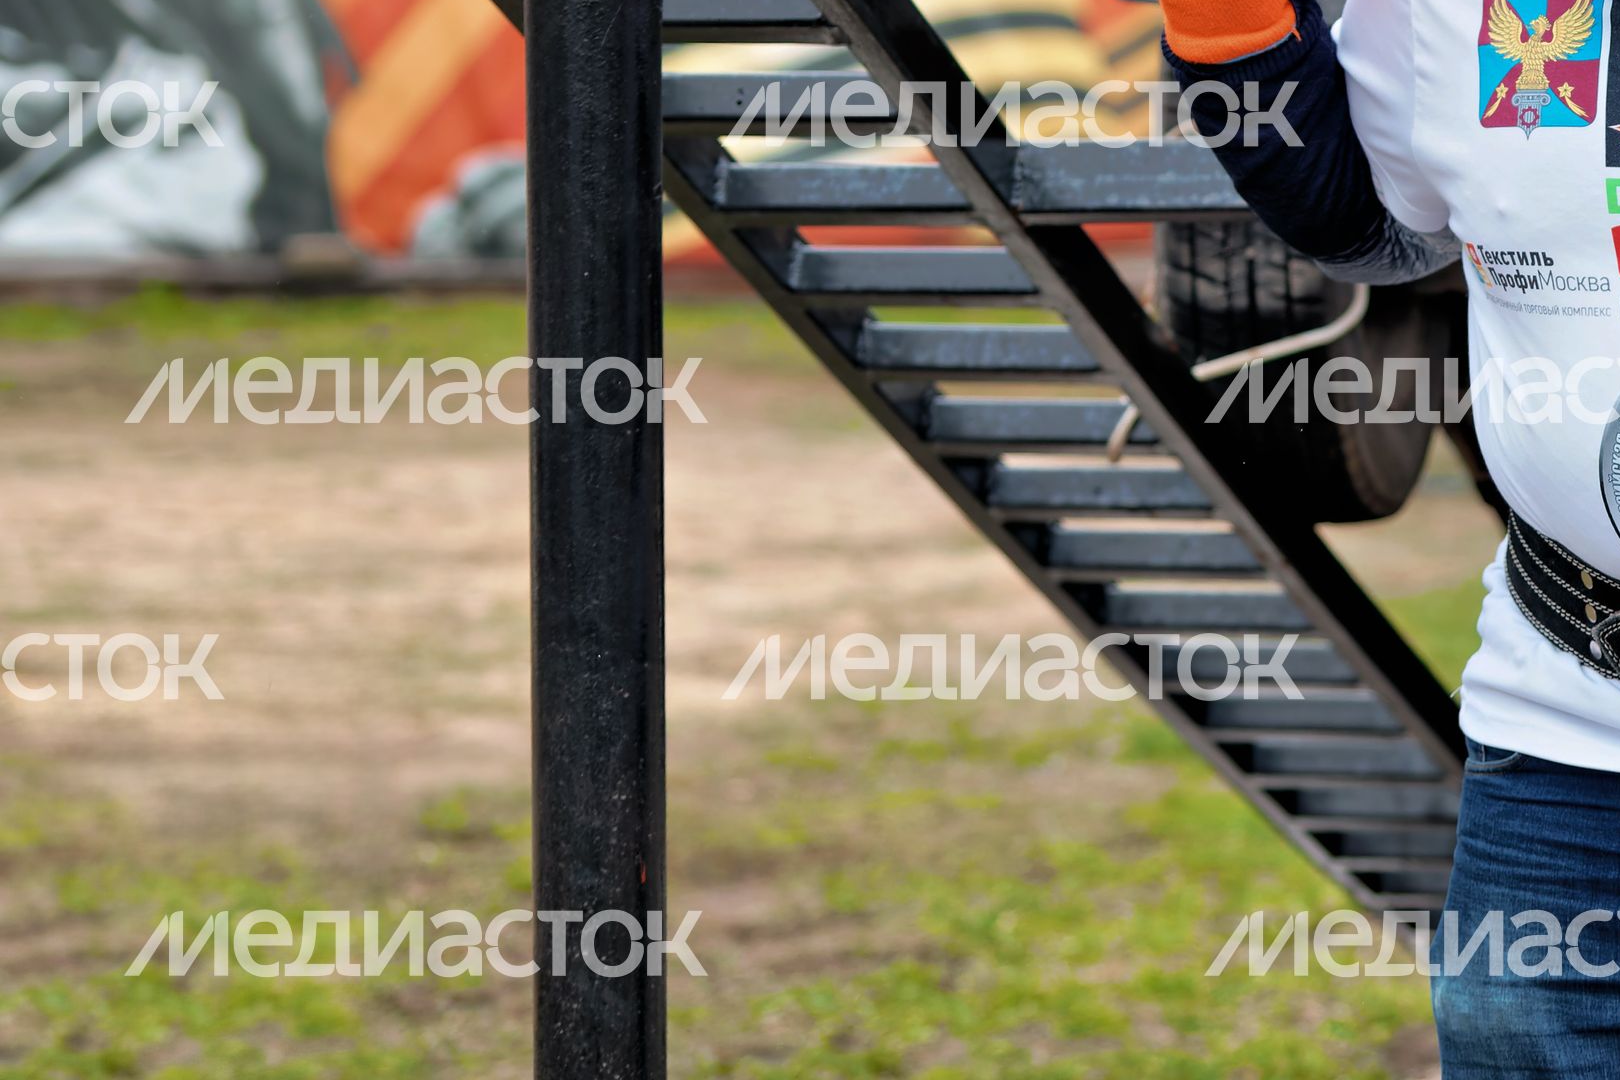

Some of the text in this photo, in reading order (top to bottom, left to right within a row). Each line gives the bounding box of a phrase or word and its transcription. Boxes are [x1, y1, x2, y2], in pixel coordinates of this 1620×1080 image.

[1477, 245, 1554, 266] Текстиль
[1523, 303, 1560, 316] ТОРГОВЫЙ
[1561, 306, 1611, 317] КОМПЛЕКС
